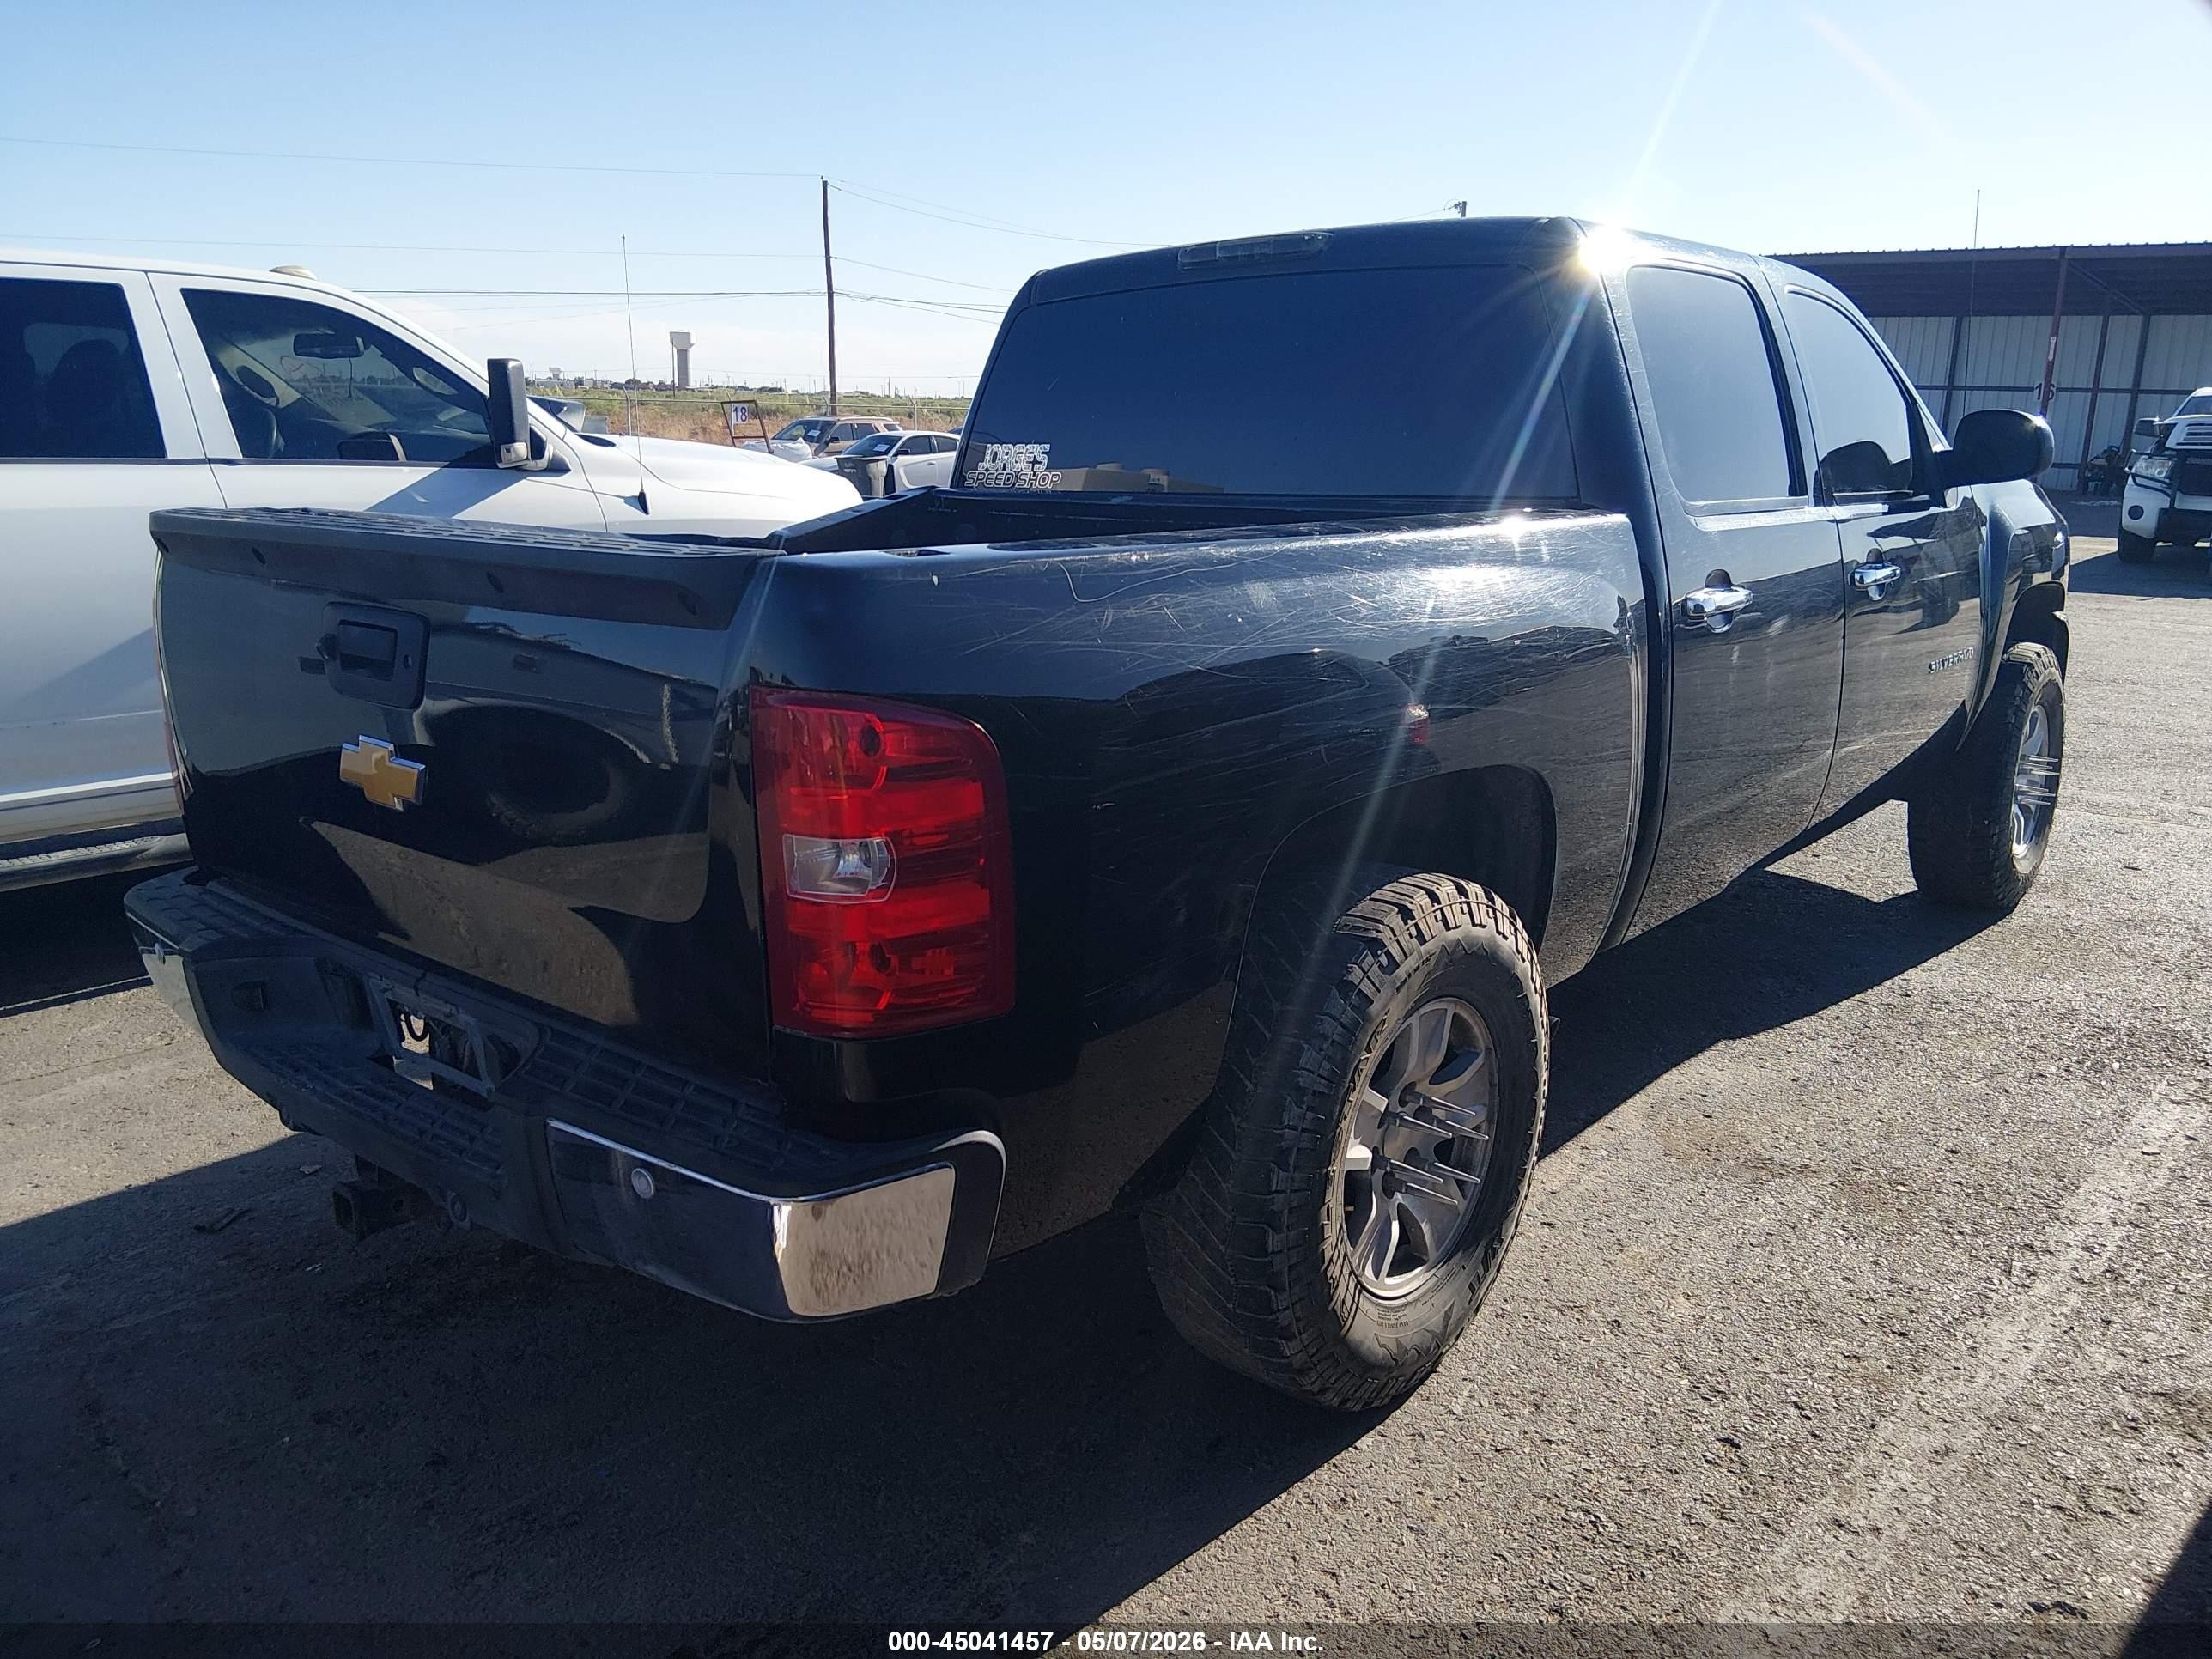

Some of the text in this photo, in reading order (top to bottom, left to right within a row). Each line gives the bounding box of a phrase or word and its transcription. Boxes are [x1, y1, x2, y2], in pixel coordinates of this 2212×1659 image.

[733, 406, 747, 422] 18
[978, 443, 1051, 471] JORGE'S
[964, 470, 1062, 489] SPEED SHOP
